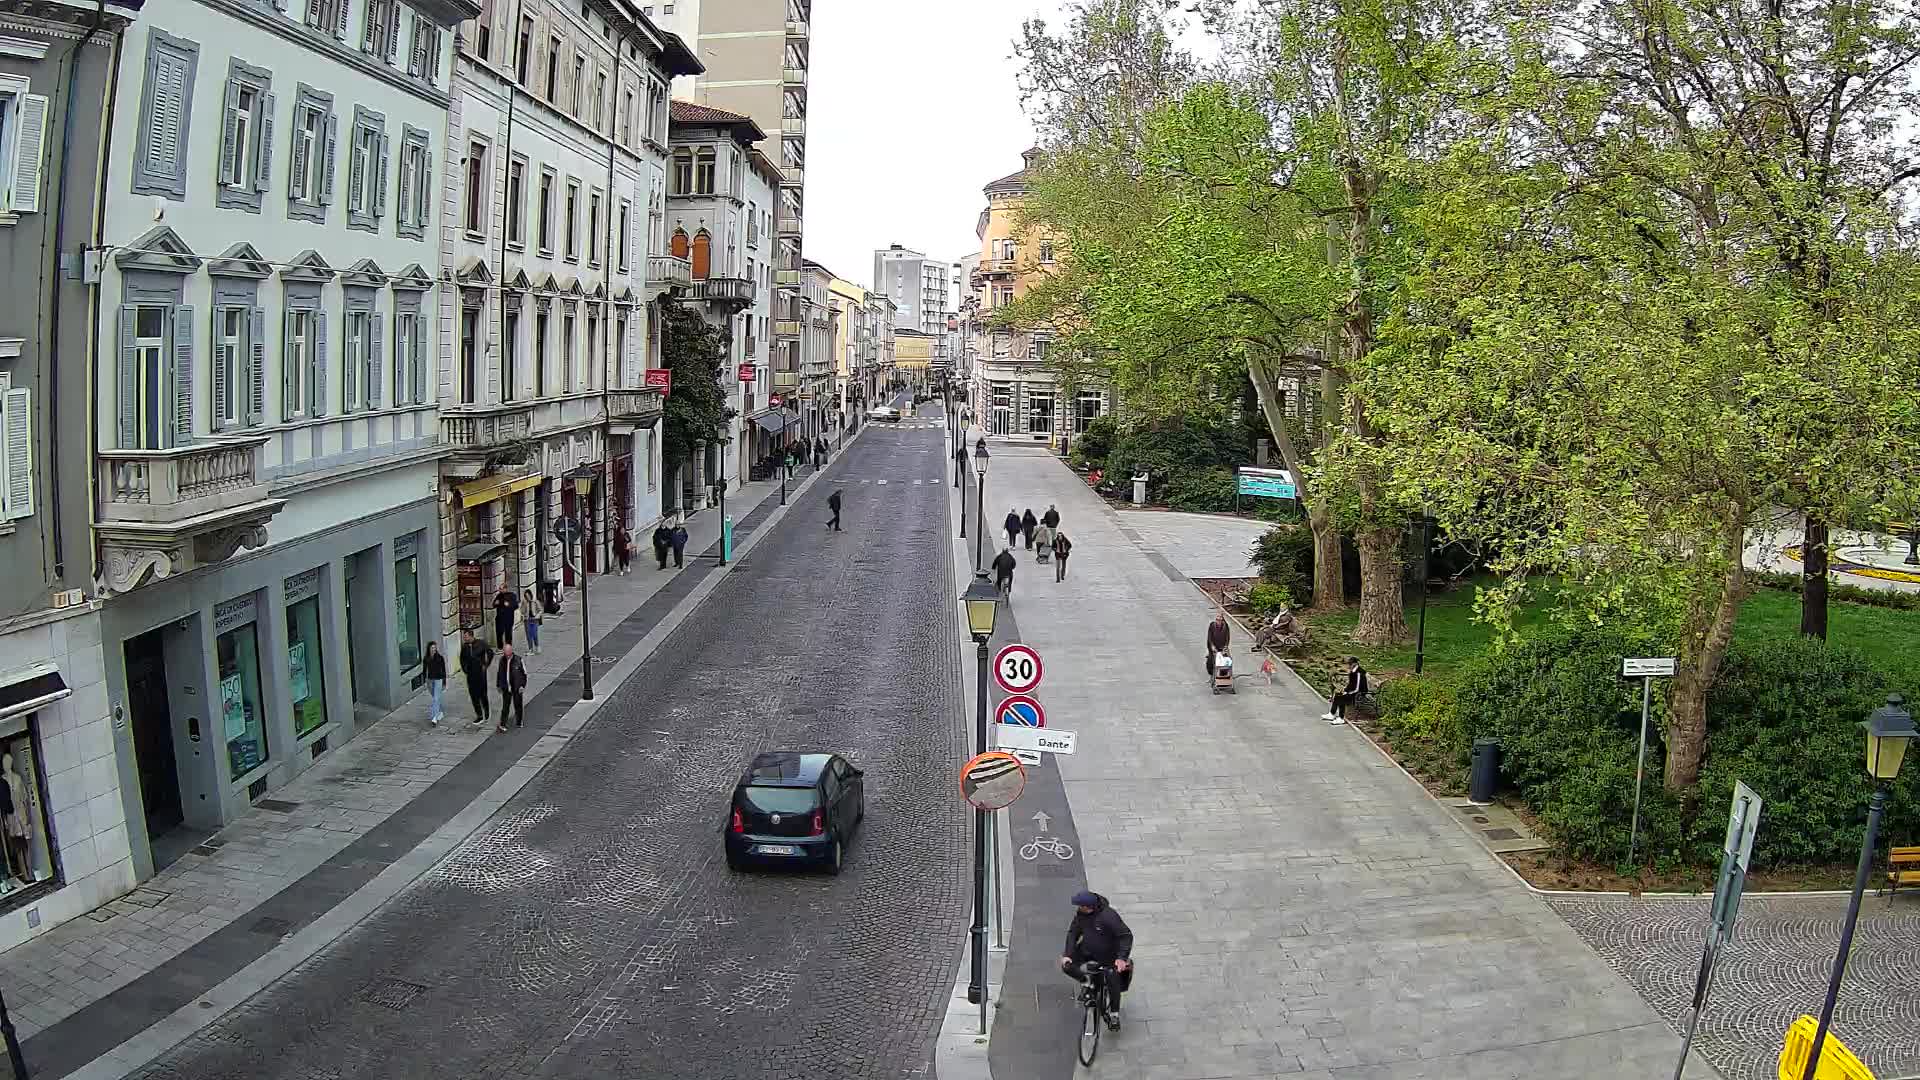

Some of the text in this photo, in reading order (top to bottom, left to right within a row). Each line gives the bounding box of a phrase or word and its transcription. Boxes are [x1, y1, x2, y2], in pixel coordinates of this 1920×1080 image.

[1005, 658, 1033, 680] 30
[222, 677, 241, 700] 130
[1038, 738, 1070, 749] Dante
